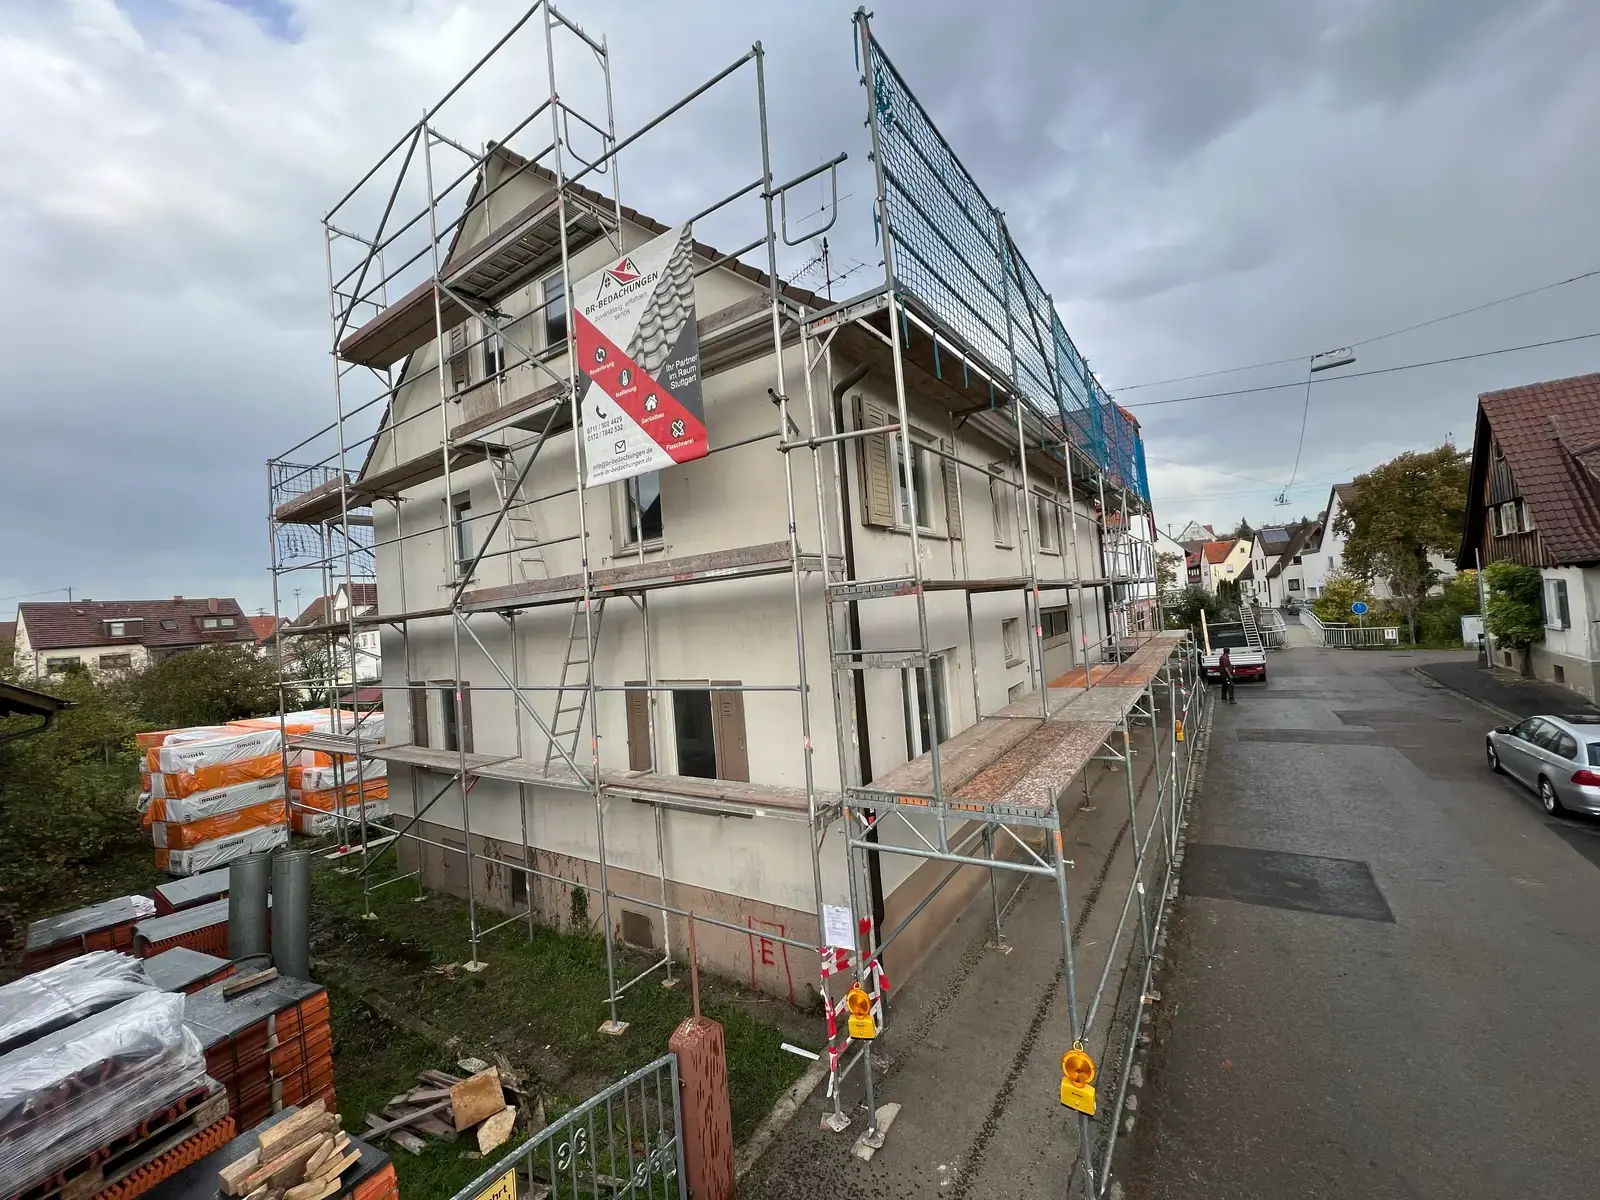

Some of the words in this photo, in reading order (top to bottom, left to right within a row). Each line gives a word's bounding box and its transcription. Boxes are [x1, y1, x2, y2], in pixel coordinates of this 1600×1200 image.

[585, 271, 659, 315] BR-BEDACHUNGEN
[614, 308, 631, 321] seriös
[589, 361, 615, 375] Renovierung
[665, 363, 674, 372] Ihr
[675, 354, 698, 369] Partner
[668, 371, 677, 380] im
[678, 365, 697, 378] Raum
[670, 373, 697, 389] Stuttgart
[615, 386, 637, 398] Isolierung
[587, 426, 598, 435] 0711
[611, 415, 623, 425] 4429
[641, 412, 665, 425] Gerüstbau
[587, 433, 599, 442] 0172
[614, 424, 624, 434] 532
[666, 437, 694, 451] Flaschnerei
[592, 447, 653, 471] info@br-bedachungen.de
[593, 456, 653, 478] www.br-bedachungen.de
[760, 936, 775, 965] E
